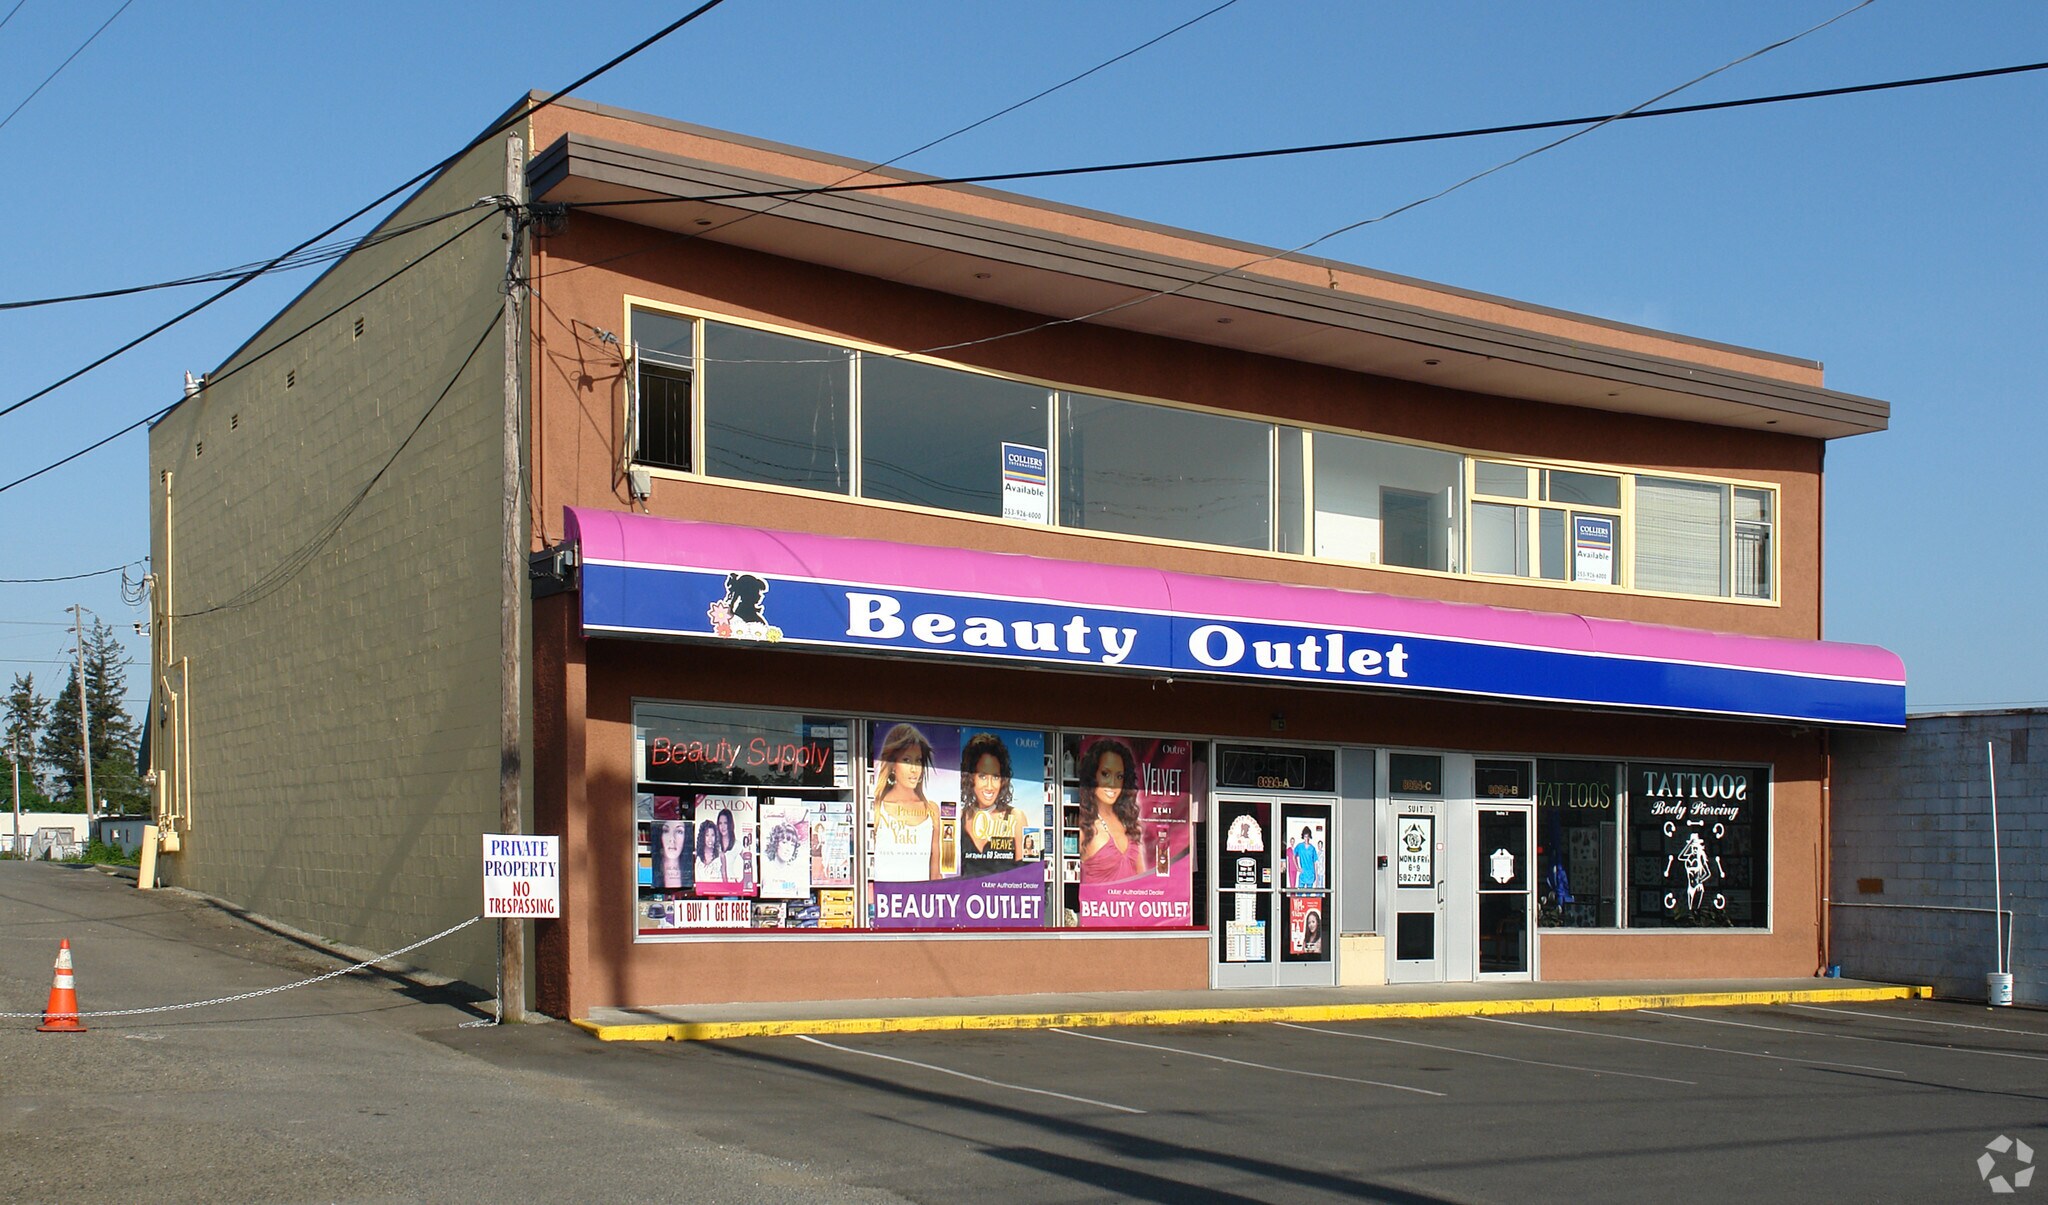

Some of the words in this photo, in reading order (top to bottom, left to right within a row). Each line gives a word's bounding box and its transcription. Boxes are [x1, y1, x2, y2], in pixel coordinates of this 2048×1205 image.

[1008, 453, 1043, 467] COLLIERS
[1005, 482, 1045, 497] Available
[1580, 525, 1608, 535] COLLIERS
[1577, 550, 1609, 561] Available
[845, 591, 1138, 665] Beauty
[1188, 624, 1410, 680] Outlet
[652, 737, 741, 769] Beauty
[747, 737, 831, 775] Supply
[1162, 744, 1186, 755] Outre
[1142, 762, 1182, 797] VELVET
[1257, 775, 1290, 788] 8024-A
[1643, 770, 1748, 801] TATTOOS
[1536, 781, 1611, 810] TATTOOS
[704, 799, 755, 812] REVLON
[1407, 805, 1424, 813] SUIT
[1429, 805, 1434, 814] 3
[1650, 800, 1687, 820] Body
[1689, 801, 1740, 821] Piercing
[972, 811, 1017, 840] Quick
[892, 828, 917, 845] Yaki
[990, 838, 1013, 850] WEAVE
[491, 840, 549, 857] PRIVATE
[484, 860, 557, 878] PROPERTY
[513, 881, 530, 897] NO
[489, 897, 554, 914] TRESPASSING
[679, 902, 683, 922] 1
[687, 902, 702, 922] BUY
[706, 902, 710, 922] 1
[715, 902, 729, 922] GET
[731, 902, 749, 922] FREE
[876, 893, 961, 919] BEAUTY
[965, 894, 1042, 920] OUTLET
[1081, 900, 1135, 918] BEAUTY
[1139, 901, 1189, 918] OUTLET
